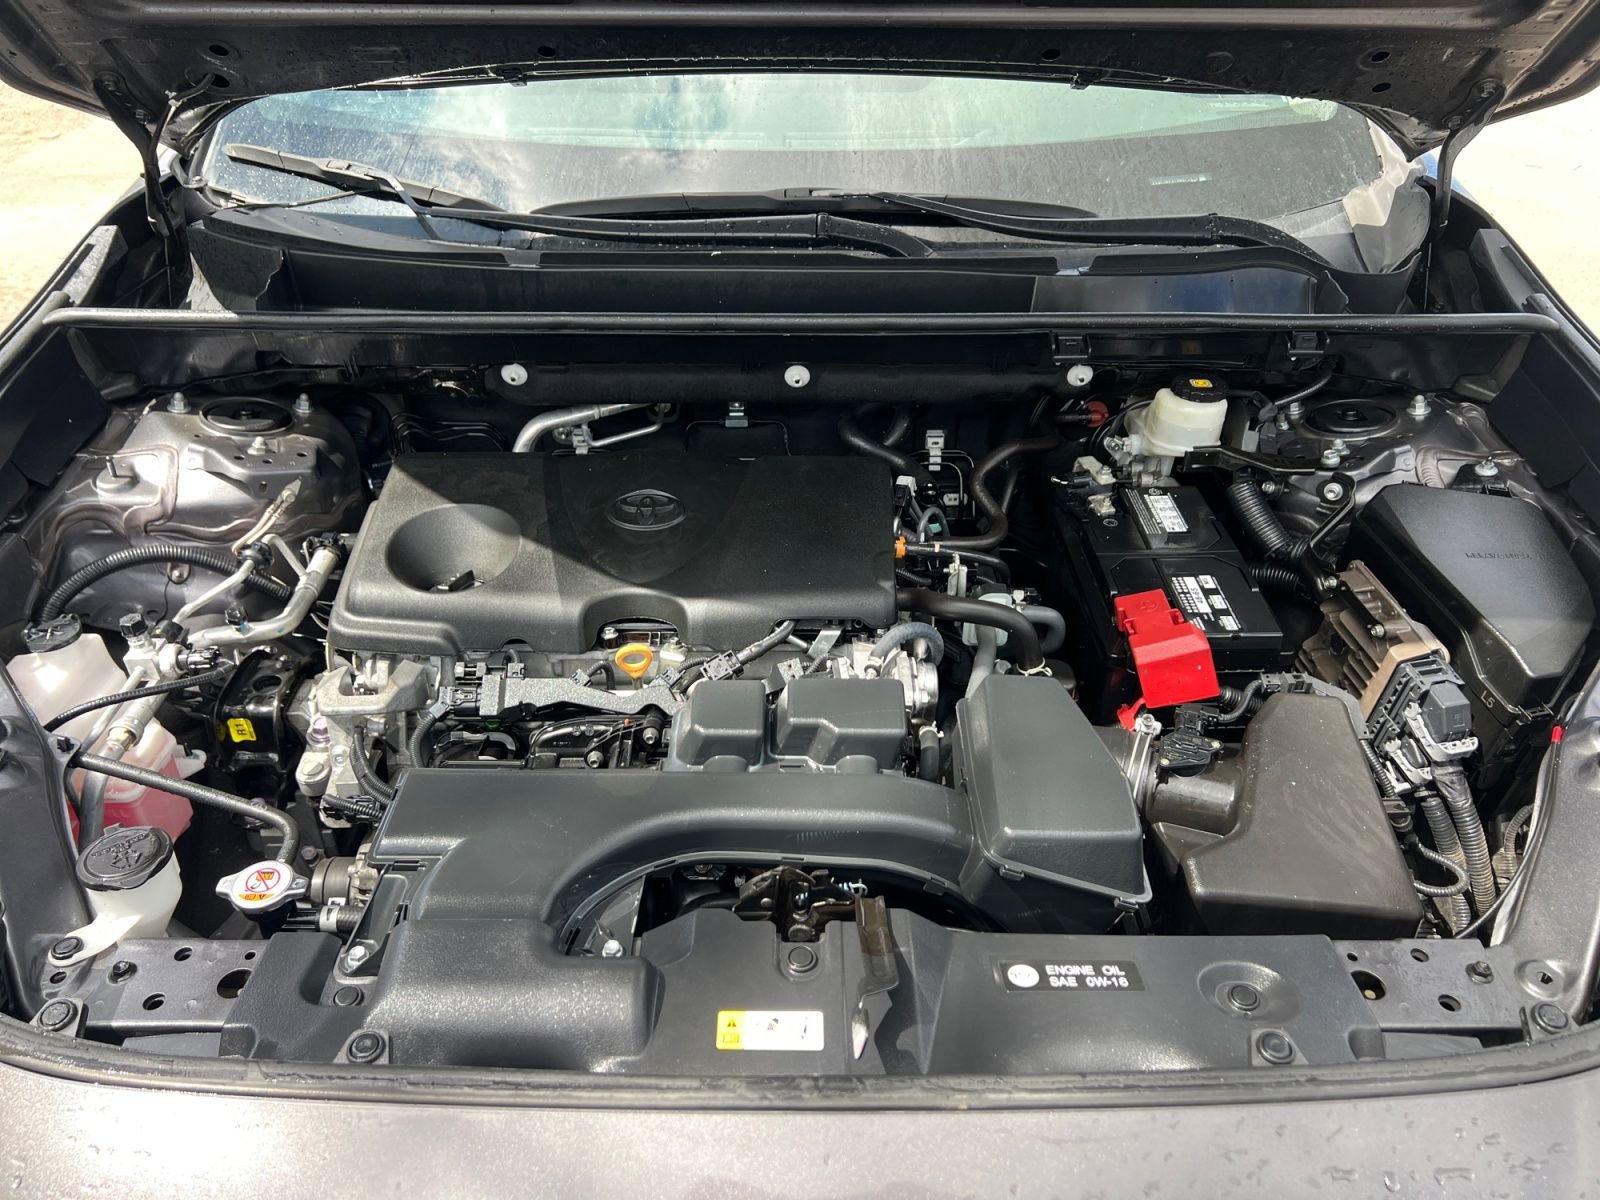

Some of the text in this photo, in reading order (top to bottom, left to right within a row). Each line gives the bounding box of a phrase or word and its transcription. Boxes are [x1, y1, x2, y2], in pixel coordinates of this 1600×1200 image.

[1045, 964, 1095, 976] ENGINE
[1101, 964, 1125, 976] OIL
[1048, 976, 1129, 988] SAE 0W-16
